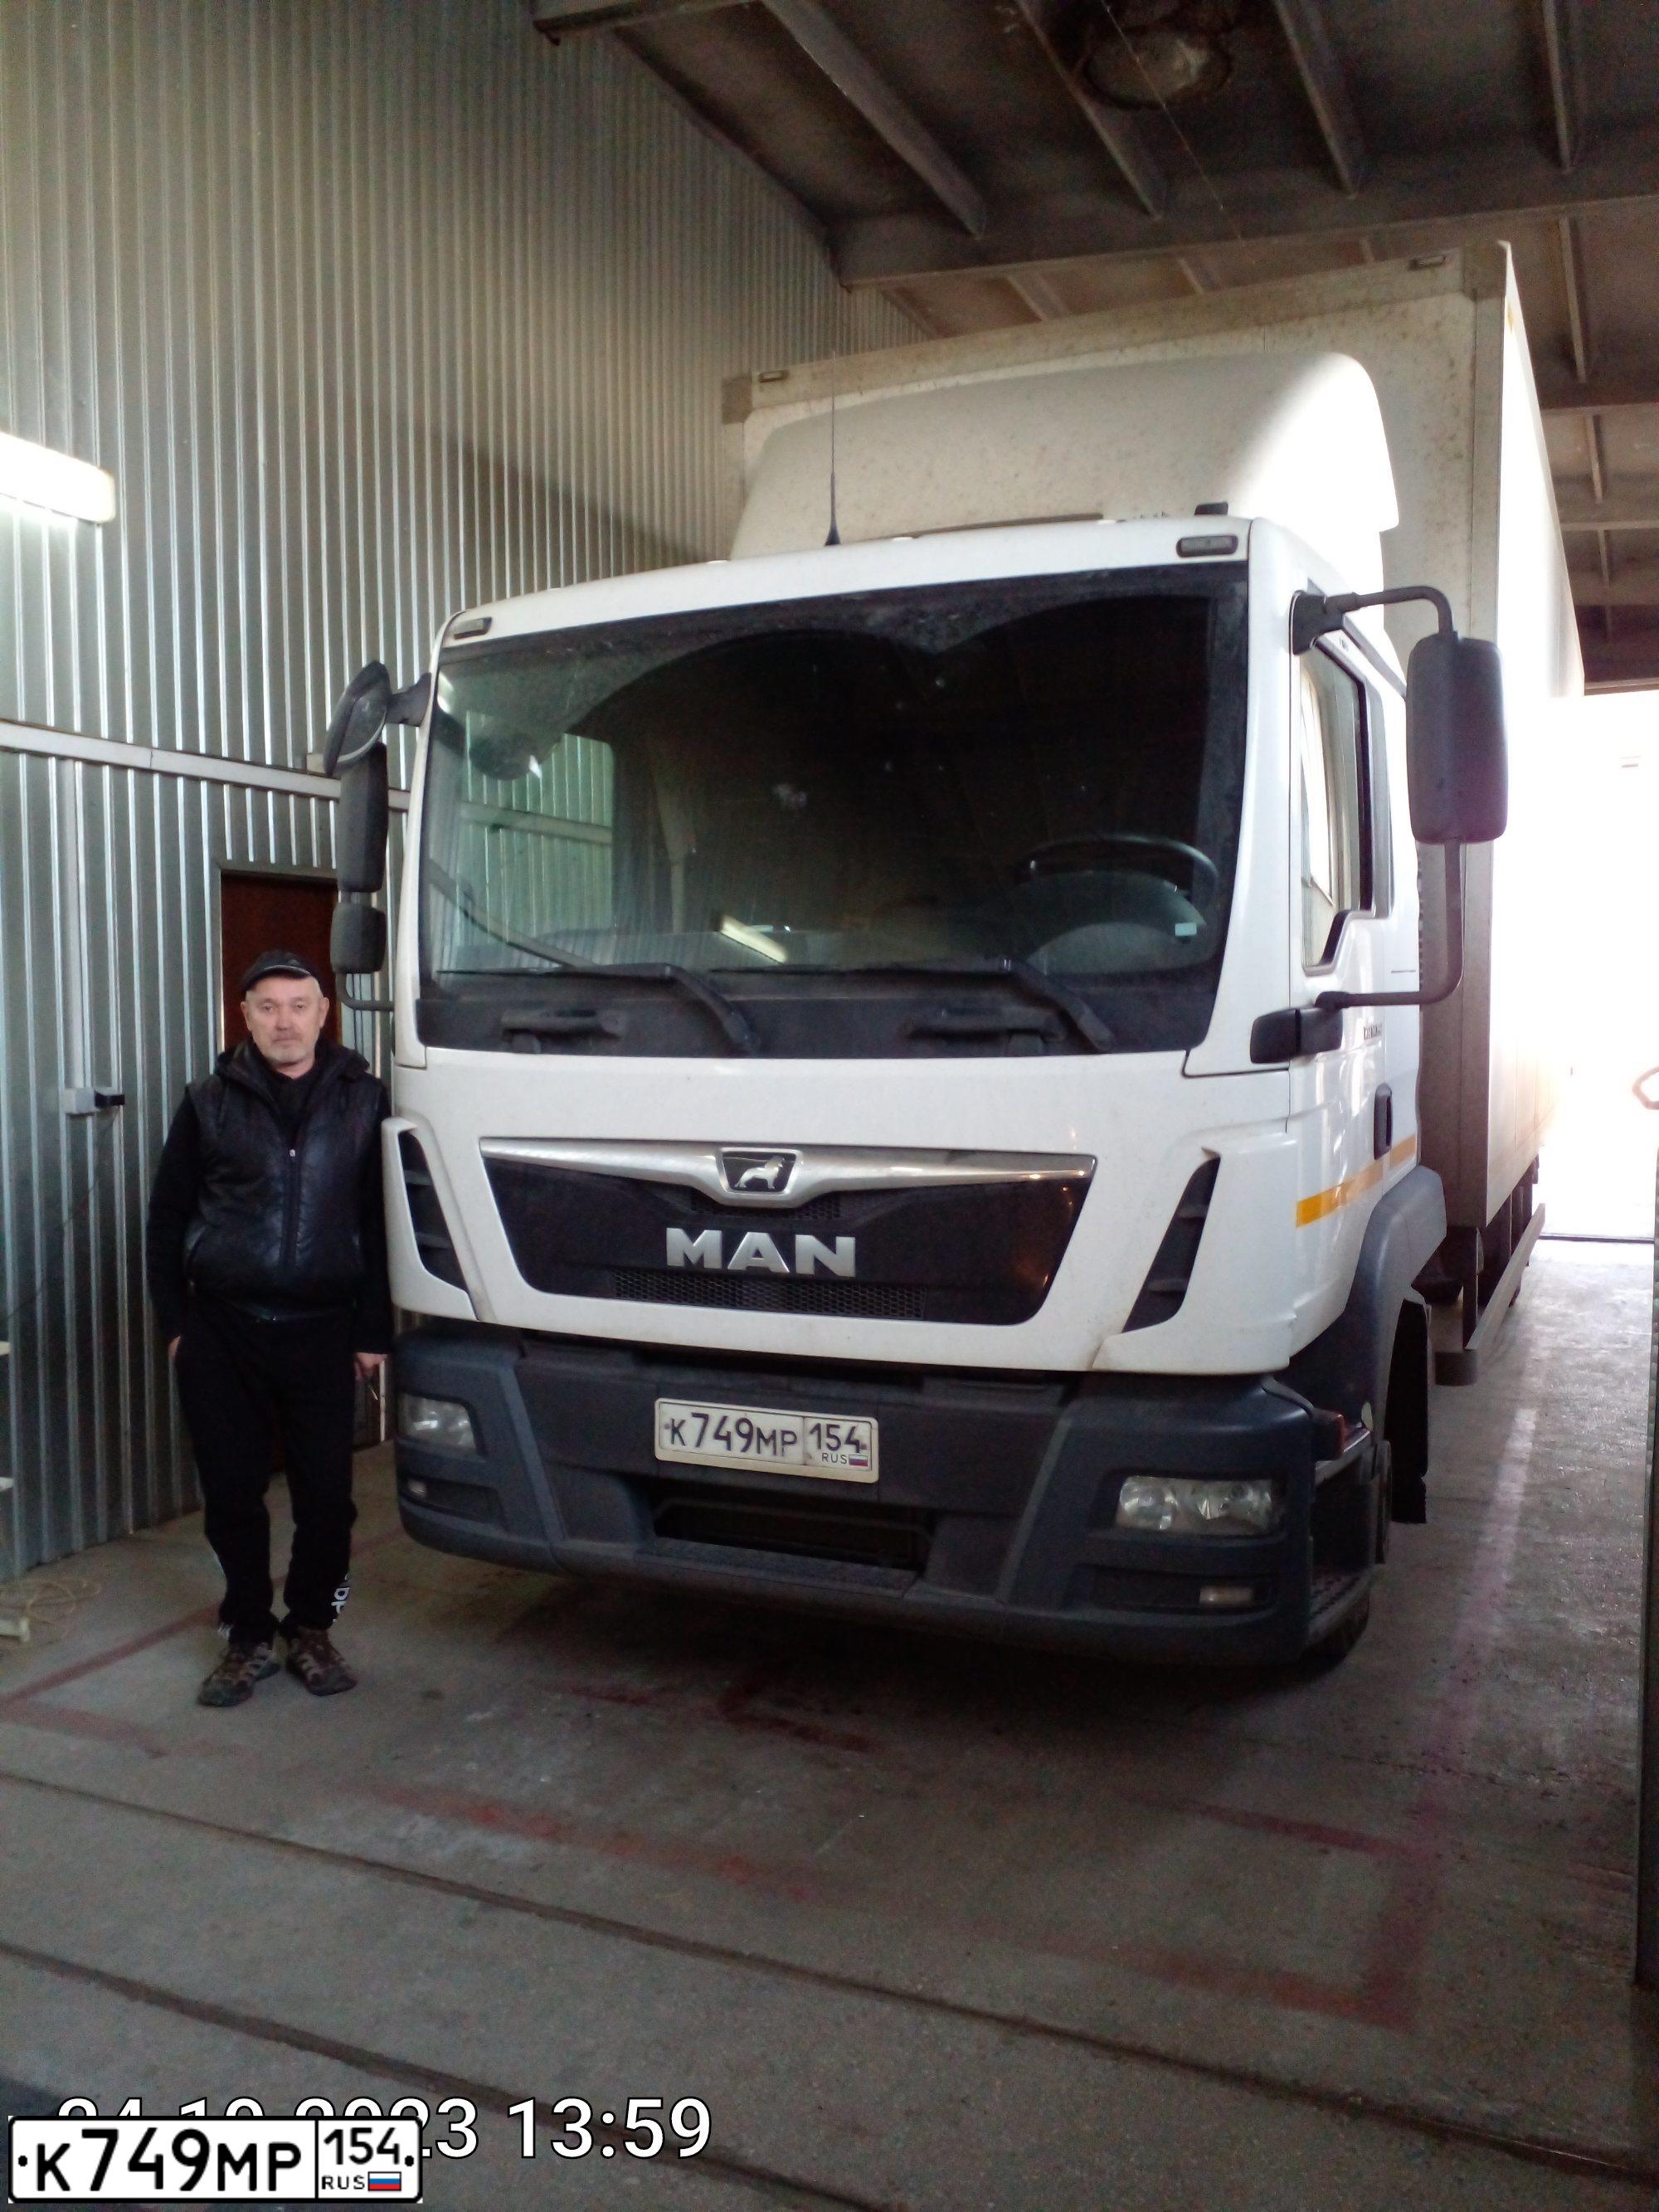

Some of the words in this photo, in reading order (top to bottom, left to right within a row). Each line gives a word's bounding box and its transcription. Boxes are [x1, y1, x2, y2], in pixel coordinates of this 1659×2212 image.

[666, 1227, 856, 1278] MAN
[670, 1411, 798, 1457] К749МР
[810, 1422, 861, 1454] 154
[821, 1452, 848, 1465] RUS
